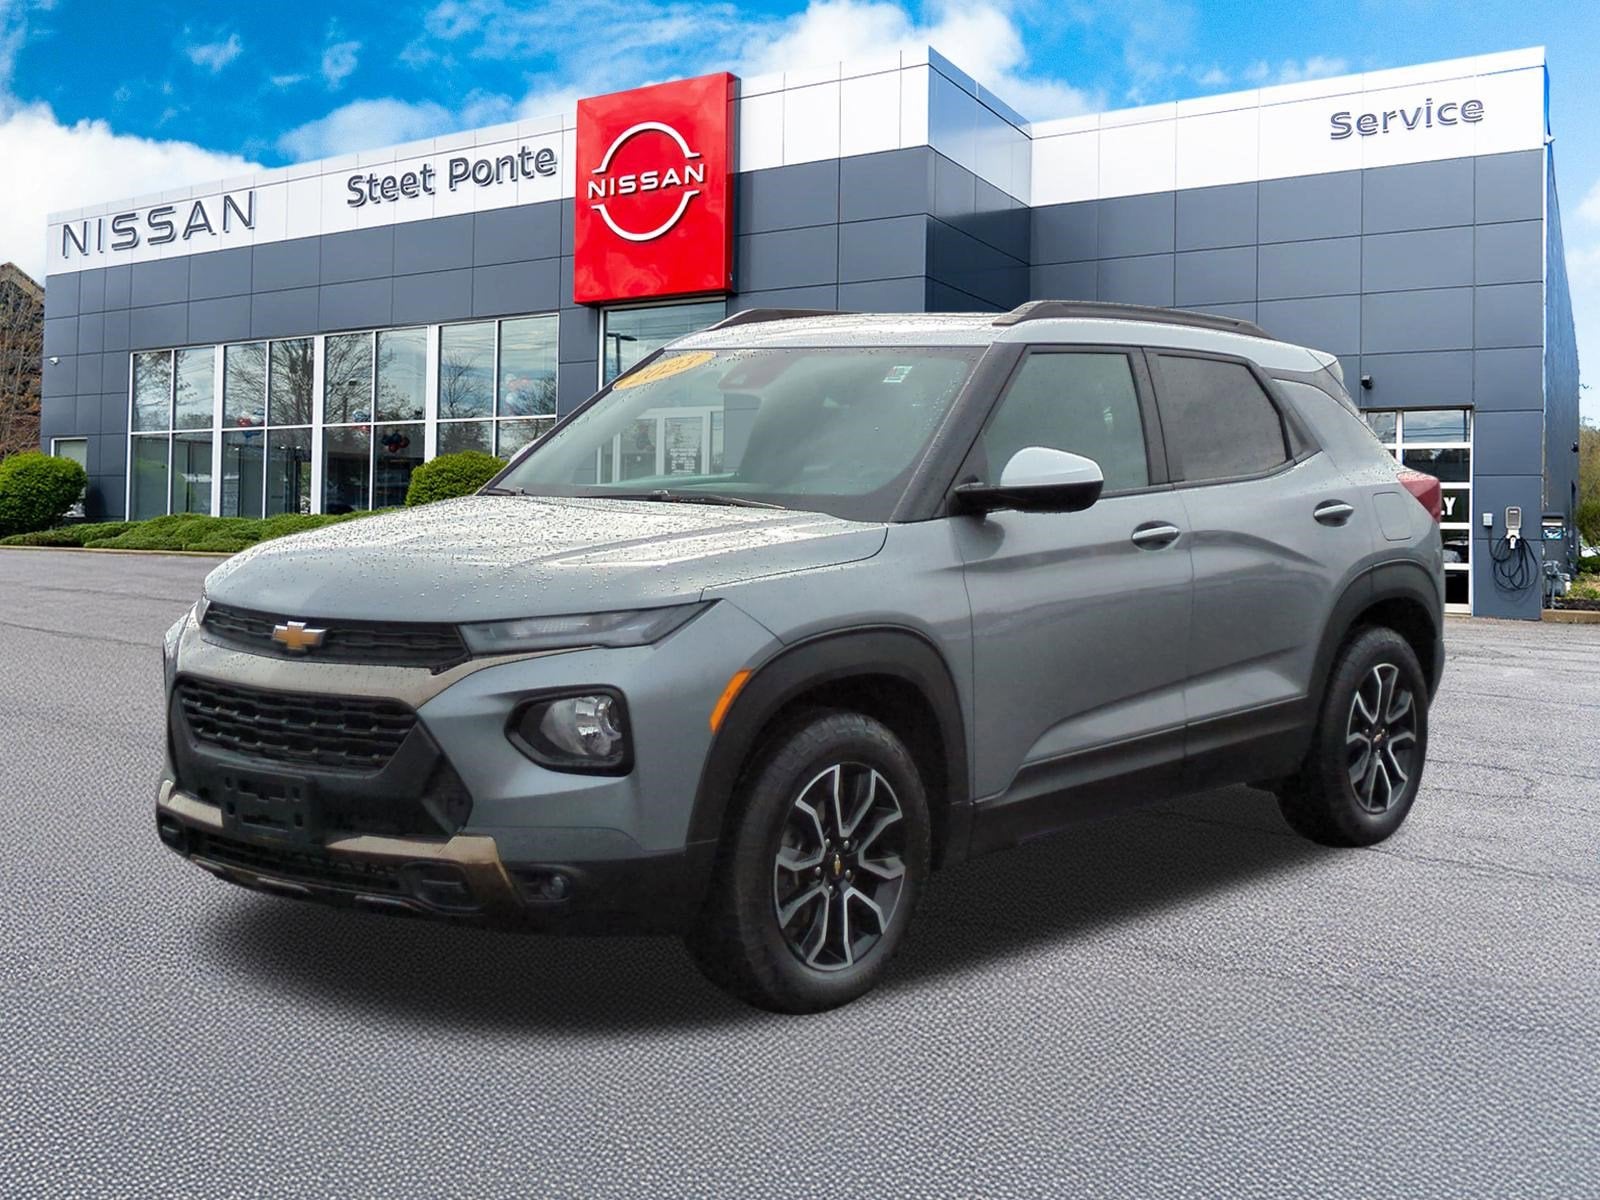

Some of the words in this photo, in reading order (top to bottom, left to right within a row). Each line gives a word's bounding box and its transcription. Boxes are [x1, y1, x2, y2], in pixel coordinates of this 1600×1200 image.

[1330, 98, 1484, 140] Service
[347, 163, 435, 207] Steet
[449, 146, 557, 191] Ponte
[588, 164, 704, 199] NISSAN
[62, 190, 256, 259] NISSAN
